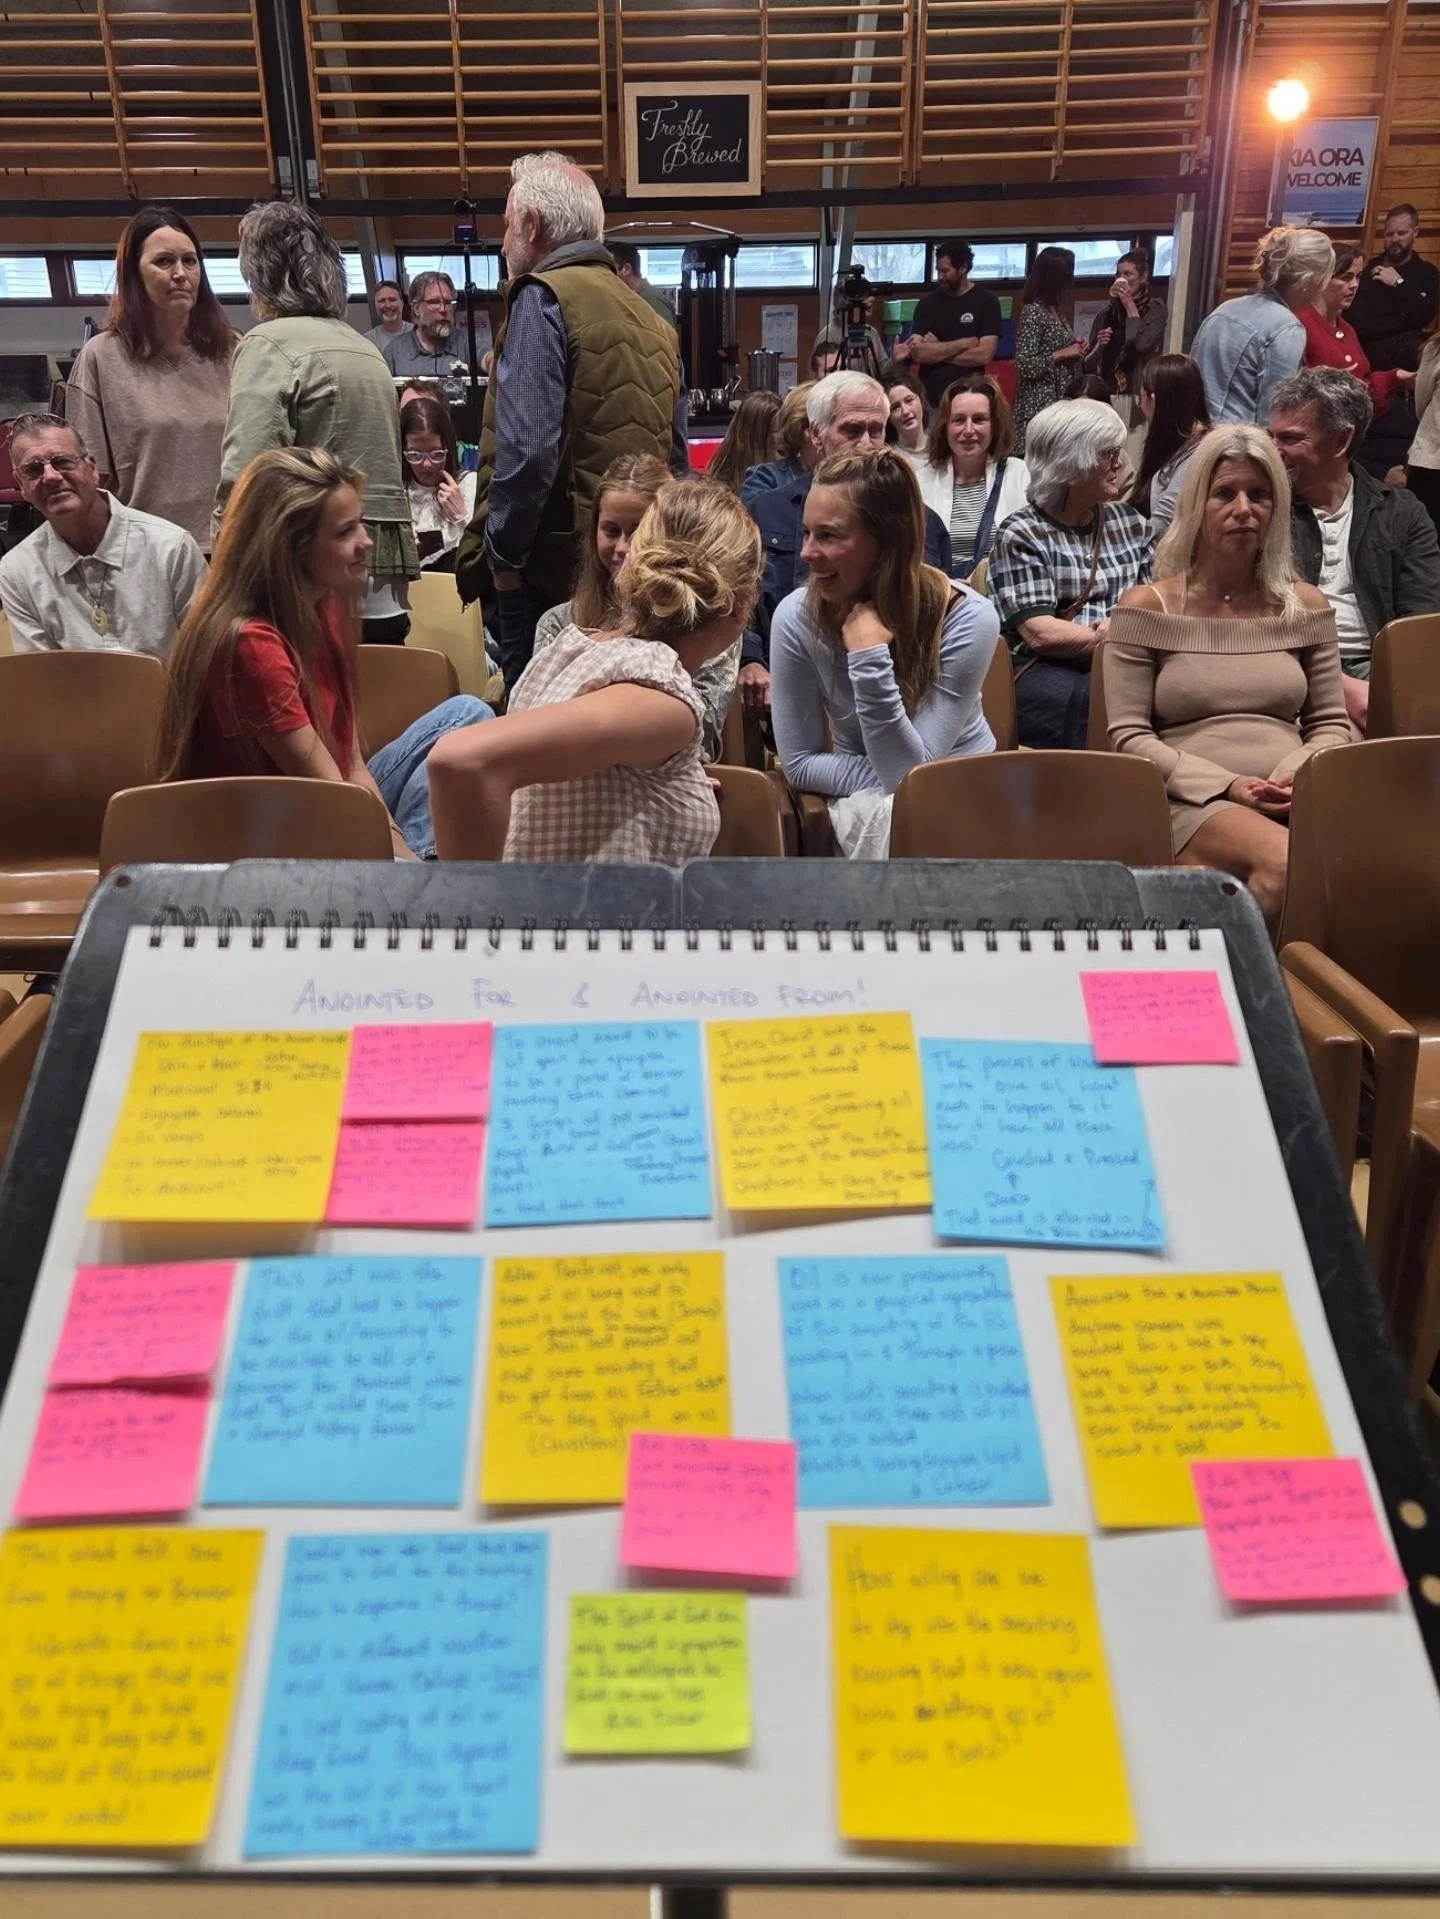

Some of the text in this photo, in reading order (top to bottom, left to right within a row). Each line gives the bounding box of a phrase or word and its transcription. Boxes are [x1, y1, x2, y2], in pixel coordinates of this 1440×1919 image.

[641, 100, 712, 150] Freshly
[662, 137, 742, 175] Brewed
[1319, 148, 1364, 166] ORA
